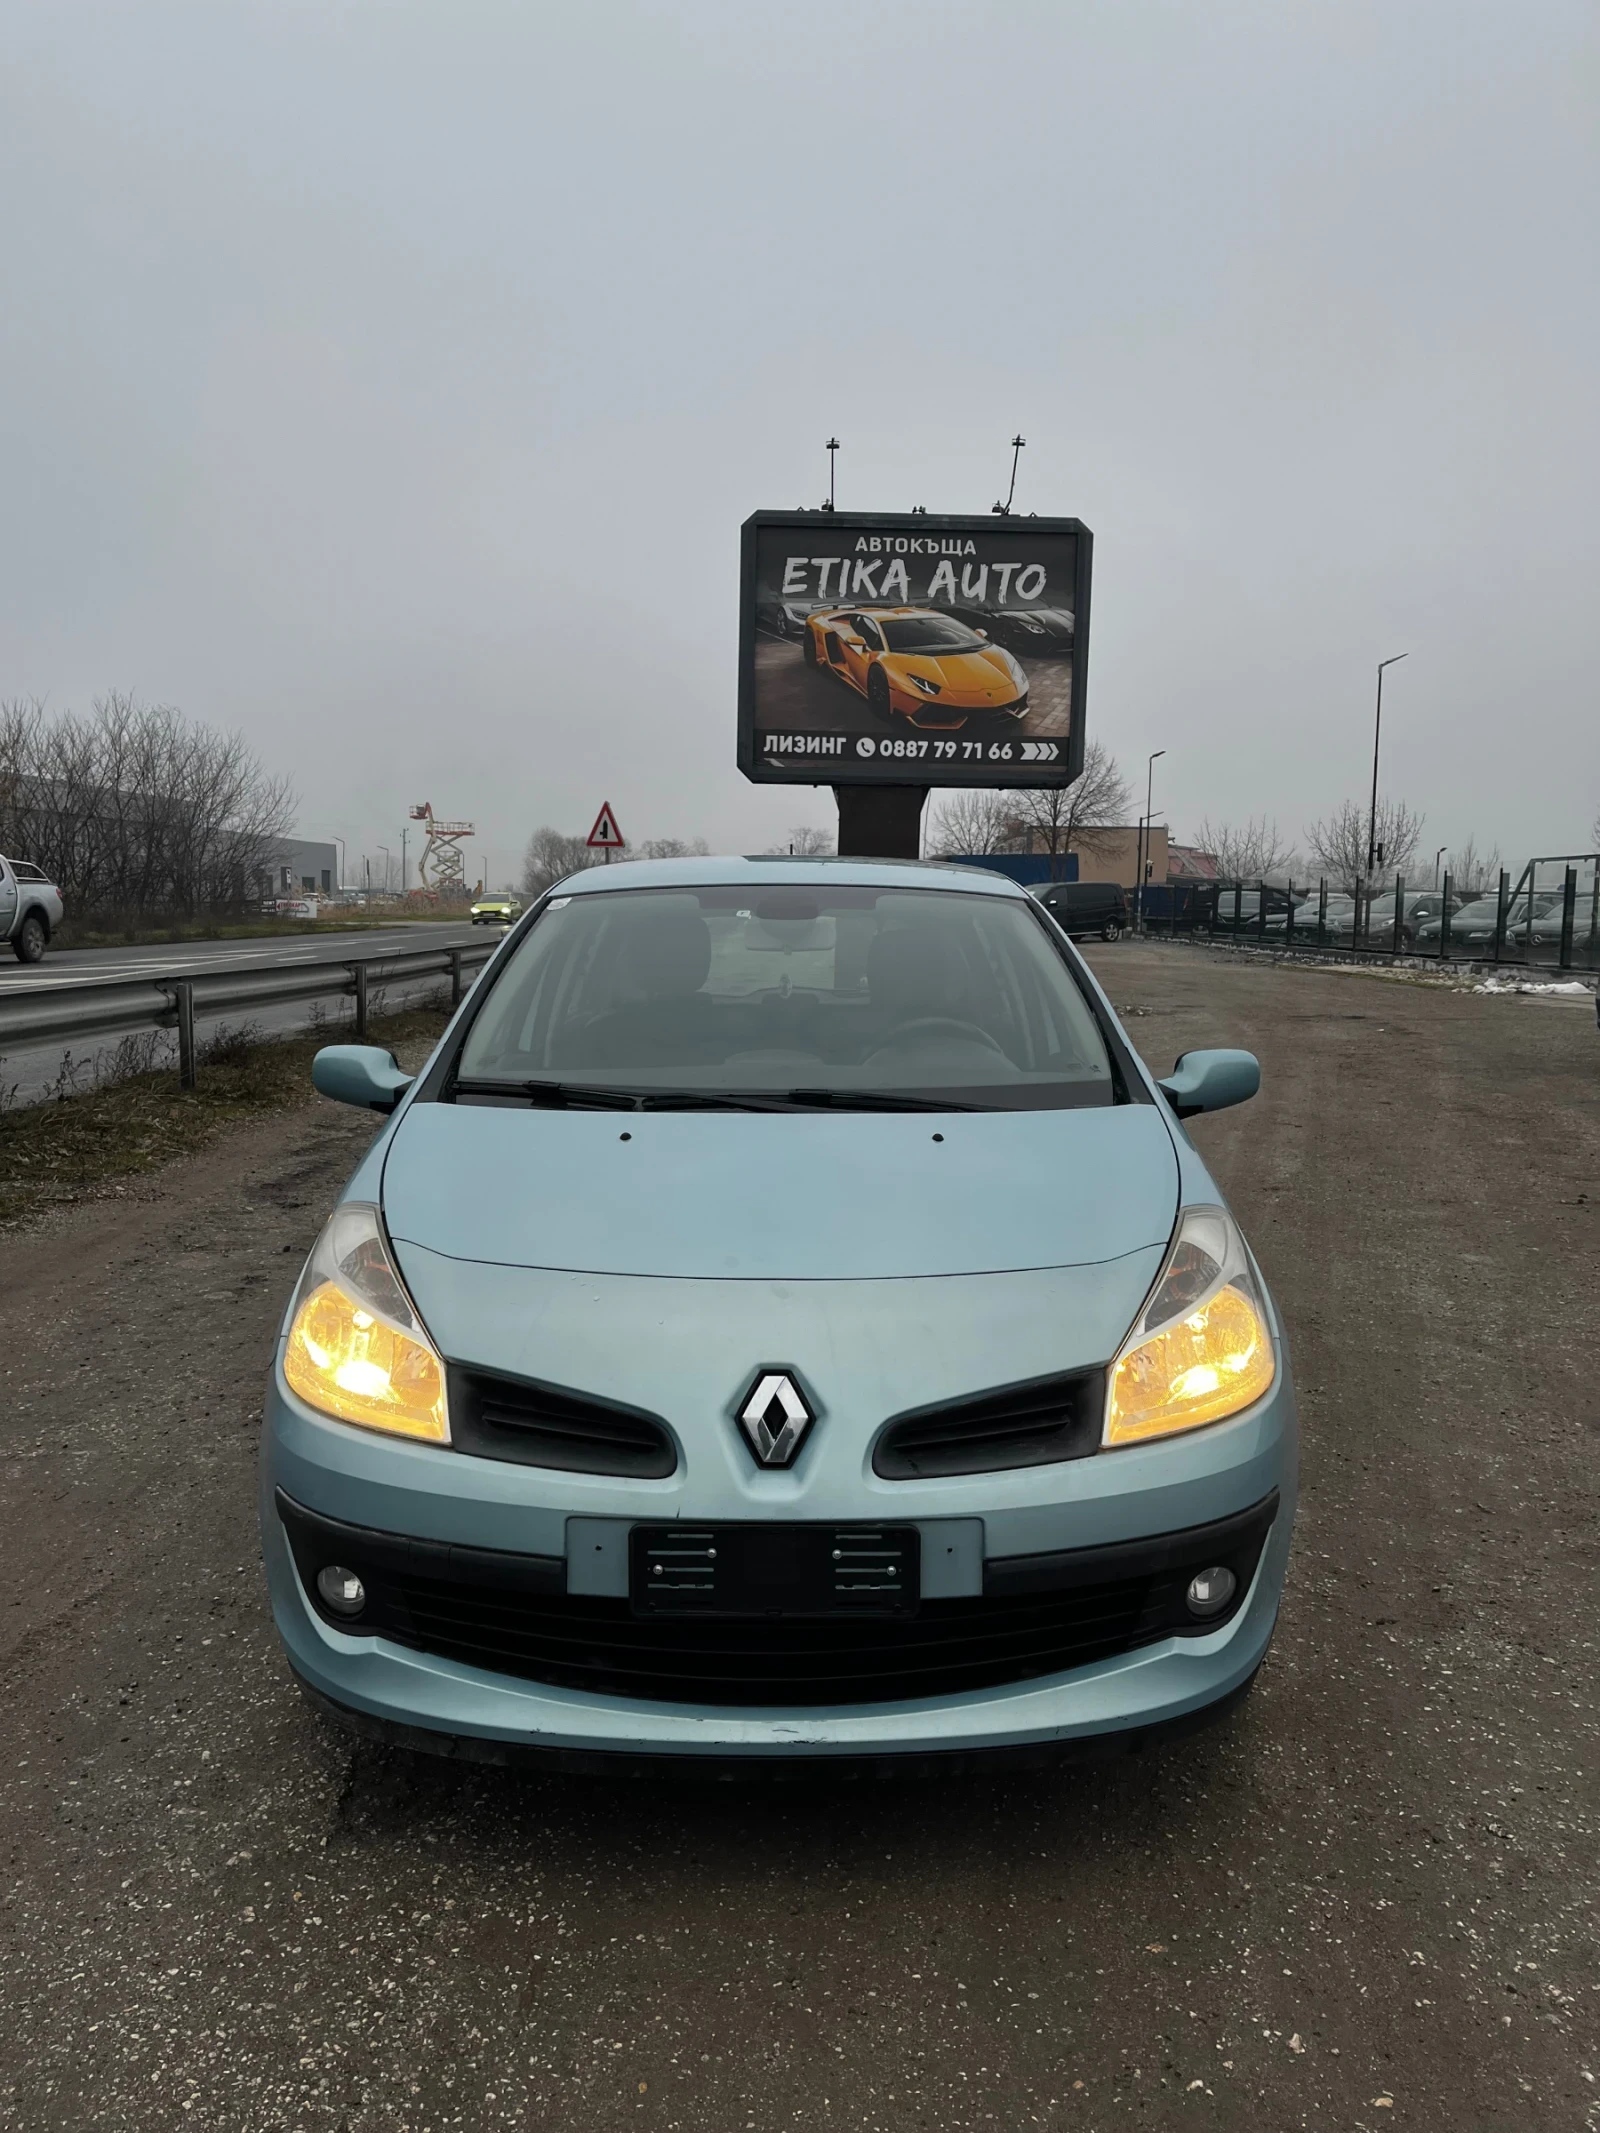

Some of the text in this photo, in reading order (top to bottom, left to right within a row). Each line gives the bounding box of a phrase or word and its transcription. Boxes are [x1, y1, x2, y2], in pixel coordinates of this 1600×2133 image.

[855, 536, 976, 556] АВТОКЪЩА
[782, 557, 1048, 605] ETIKA AUTO
[763, 735, 1013, 760] ЛИЗИНГ 0887 79 71 66
